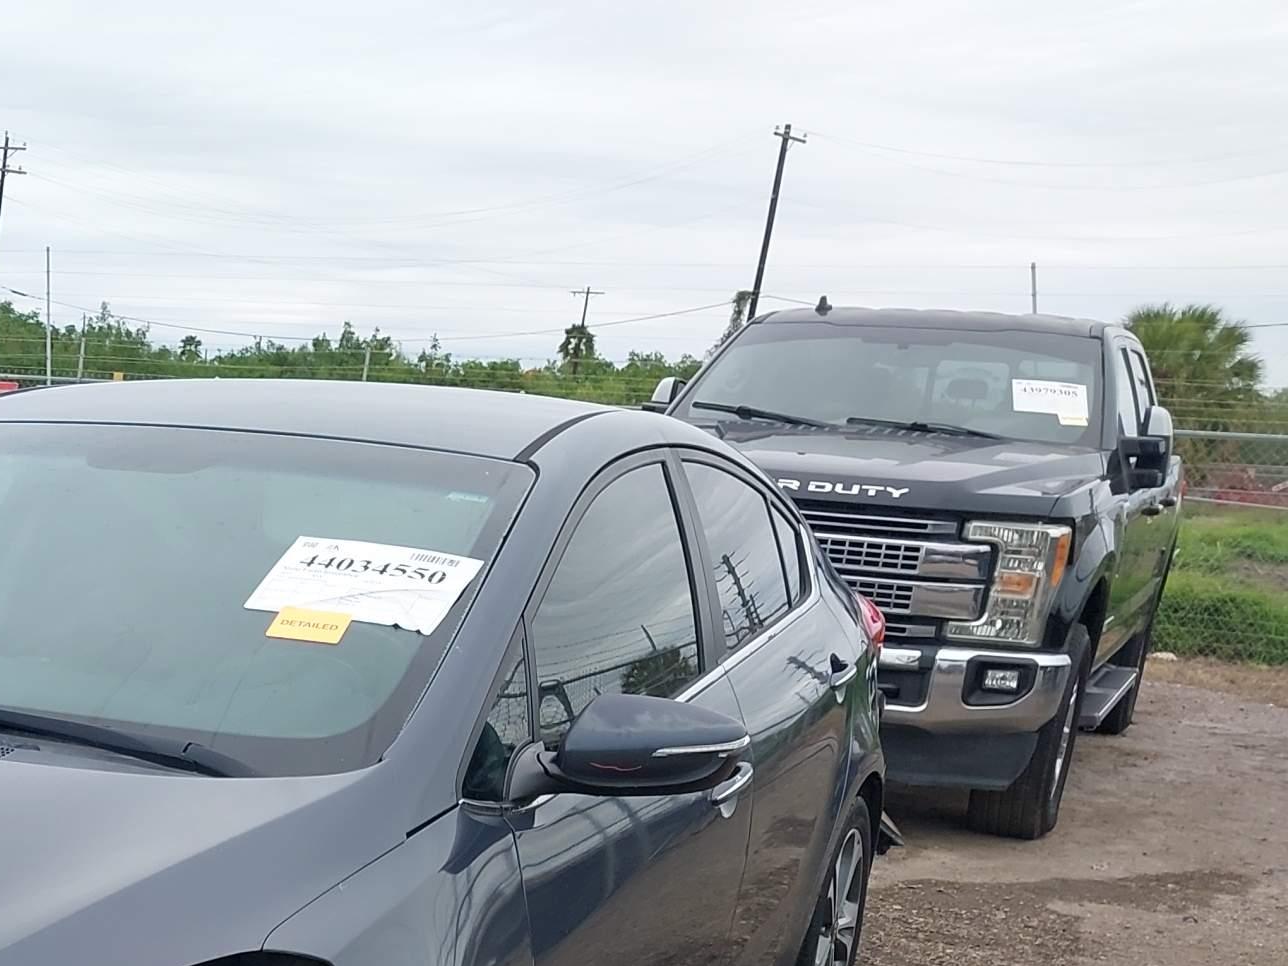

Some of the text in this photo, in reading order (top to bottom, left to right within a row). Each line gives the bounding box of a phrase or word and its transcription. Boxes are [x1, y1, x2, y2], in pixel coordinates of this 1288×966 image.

[807, 481, 910, 498] DUTY
[299, 554, 447, 584] 44034550
[279, 619, 339, 631] DETAILED
